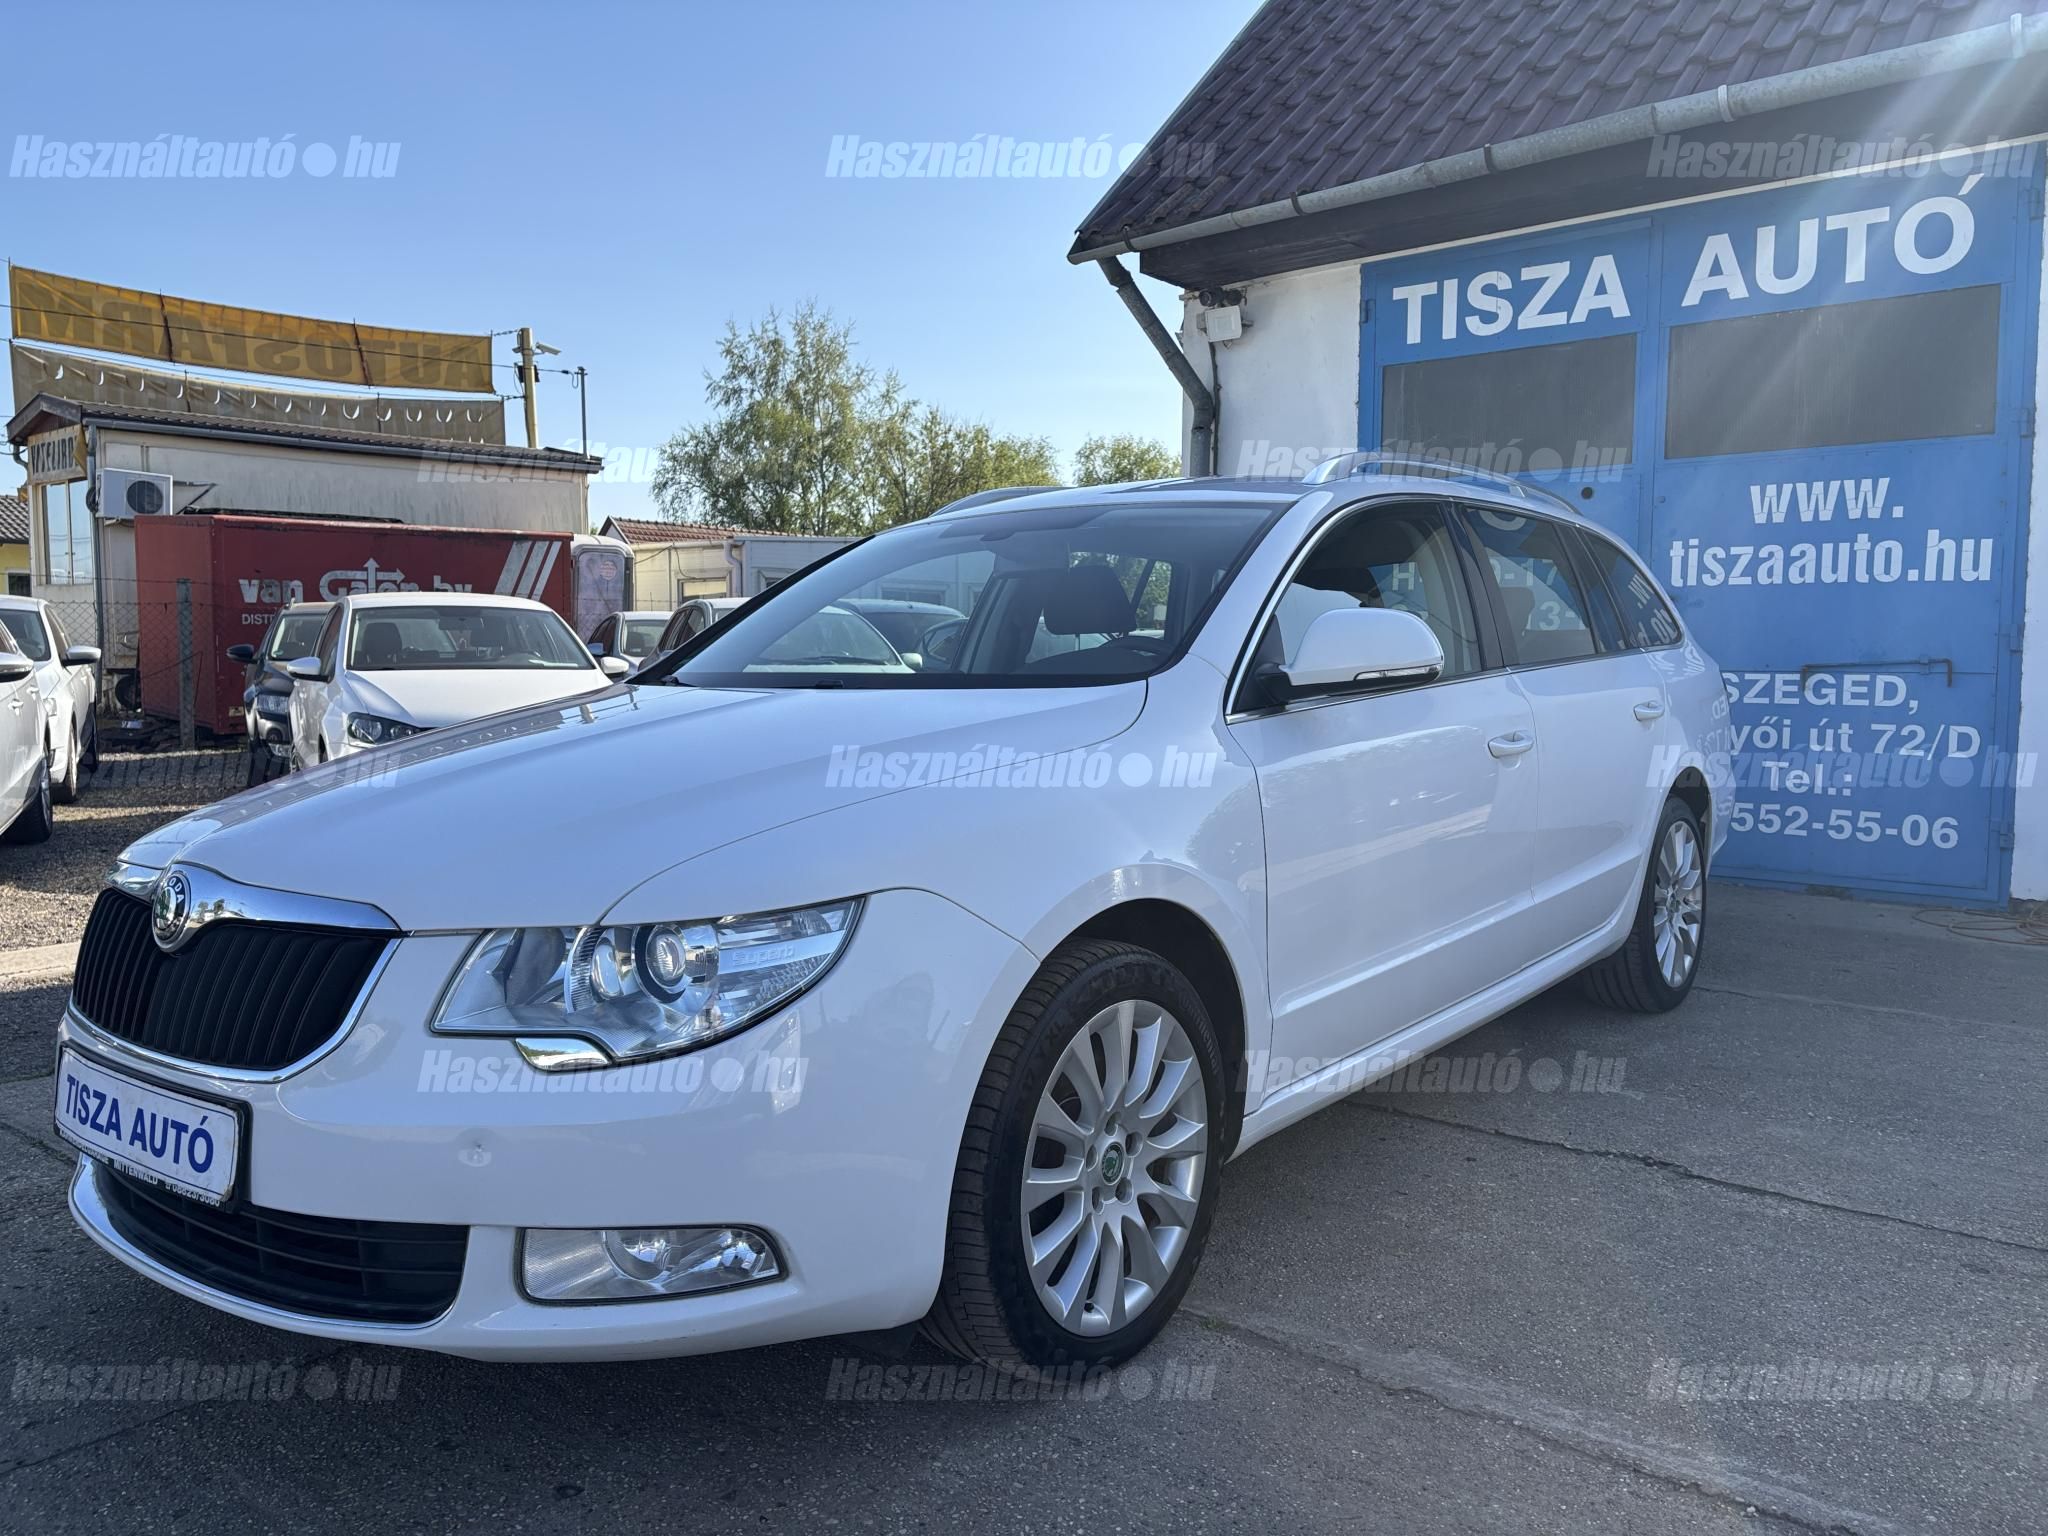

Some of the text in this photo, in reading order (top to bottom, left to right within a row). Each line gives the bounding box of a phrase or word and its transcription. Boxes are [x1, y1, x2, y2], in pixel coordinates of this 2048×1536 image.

[1392, 173, 1984, 345] TISZA AUTÓ
[1750, 477, 1904, 524] www.
[1670, 529, 1993, 587] tiszaauto.hu
[238, 579, 304, 603] van
[1722, 672, 1919, 715] SZEGED,
[1730, 716, 1981, 760] yői út 72/D
[66, 1074, 122, 1141] TISZA
[128, 1108, 214, 1173] AUTÓ
